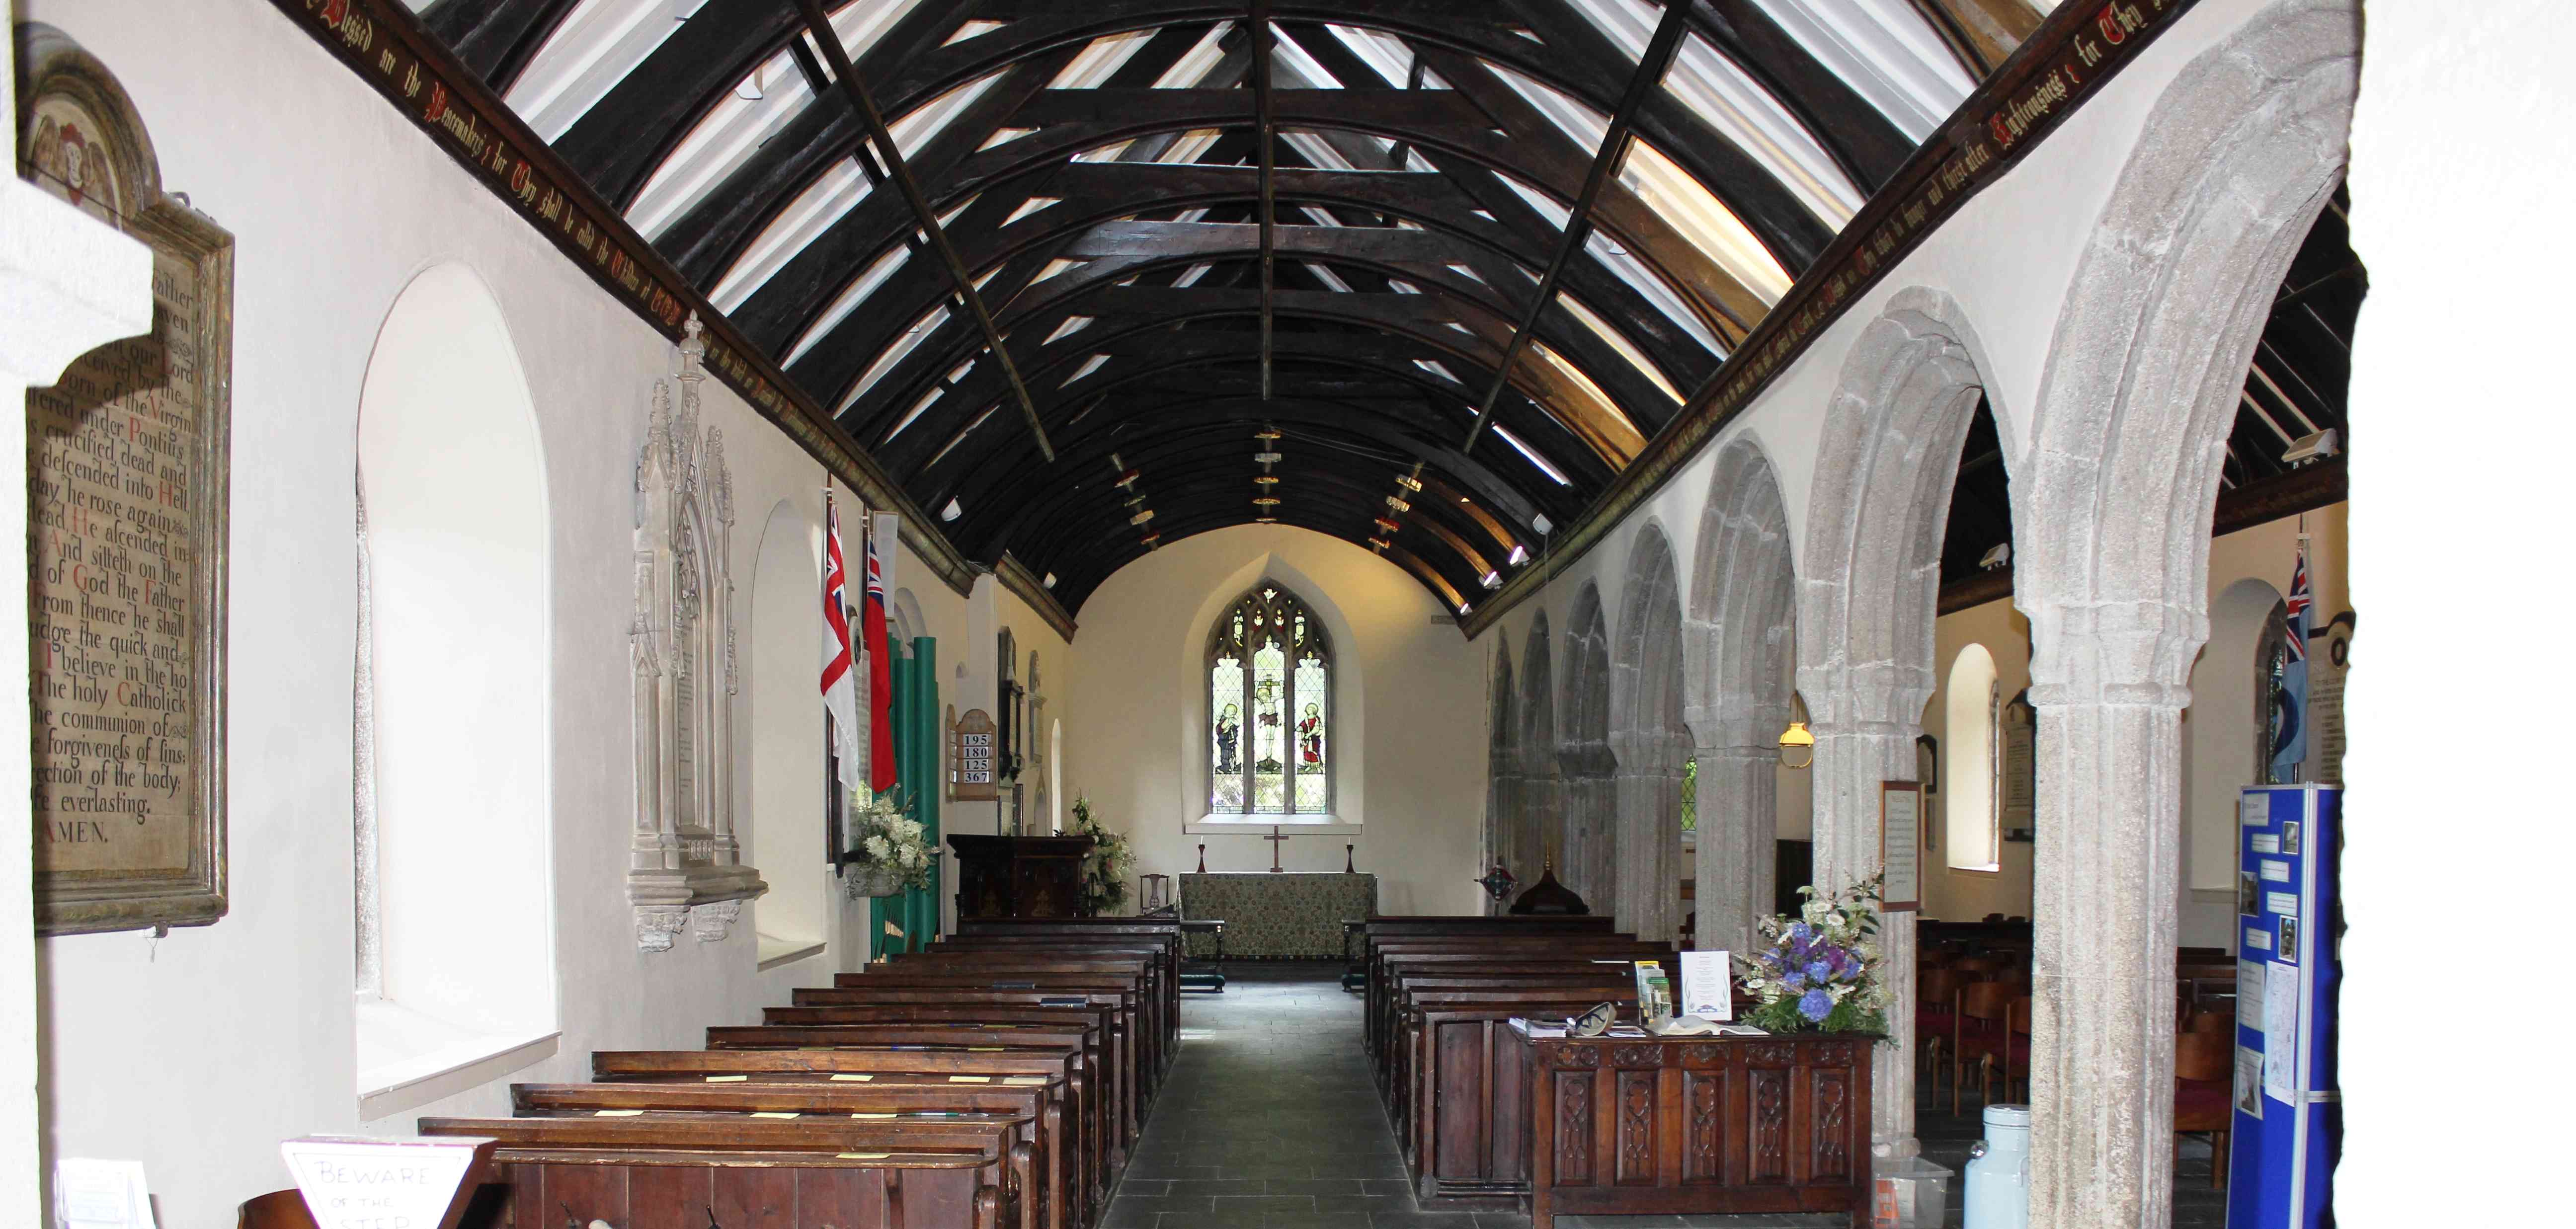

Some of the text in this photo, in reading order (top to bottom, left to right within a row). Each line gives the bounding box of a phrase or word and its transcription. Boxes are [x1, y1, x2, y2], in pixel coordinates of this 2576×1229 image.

[2075, 34, 2102, 67] for
[2098, 2, 2149, 45] They
[379, 48, 397, 75] are
[404, 59, 421, 98] the
[492, 141, 507, 175] for
[511, 159, 537, 207] They
[536, 187, 563, 223] shall
[564, 204, 574, 234] be
[597, 237, 609, 265] the
[155, 307, 188, 334] aven
[79, 354, 131, 383] ceived
[102, 380, 122, 406] of
[125, 391, 148, 416] the
[150, 396, 191, 442] Virgin
[80, 407, 124, 437] under
[129, 416, 184, 460] Pontius
[121, 440, 155, 476] dead
[160, 461, 186, 486] and
[65, 474, 85, 506] he
[90, 493, 122, 518] rose
[127, 506, 174, 534] again
[126, 473, 154, 500] into
[73, 506, 98, 538] He
[50, 528, 82, 562] And
[91, 545, 132, 574] sitteth
[139, 563, 156, 579] on
[161, 558, 182, 587] the
[47, 558, 66, 585] of
[74, 563, 109, 596] God
[117, 572, 139, 602] the
[144, 579, 185, 612] Father
[80, 591, 126, 625] thence
[130, 602, 149, 630] he
[156, 609, 184, 637] shall
[30, 612, 179, 662] udge the quick and
[47, 643, 187, 689] I believe in the ho
[68, 673, 108, 710] holy
[117, 681, 187, 713] Catholick
[32, 698, 170, 738] he communion of
[137, 737, 153, 762] of
[965, 735, 987, 745] 195
[965, 748, 987, 757] 180
[91, 759, 110, 785] of
[115, 761, 136, 787] the
[965, 760, 988, 770] 125
[965, 772, 987, 782] 367
[33, 784, 151, 825] fe everlasting.
[46, 821, 108, 843] AMEN.
[314, 1160, 430, 1185] BEWARE
[330, 1198, 394, 1208] OF THE
[340, 1216, 410, 1229] STEP
